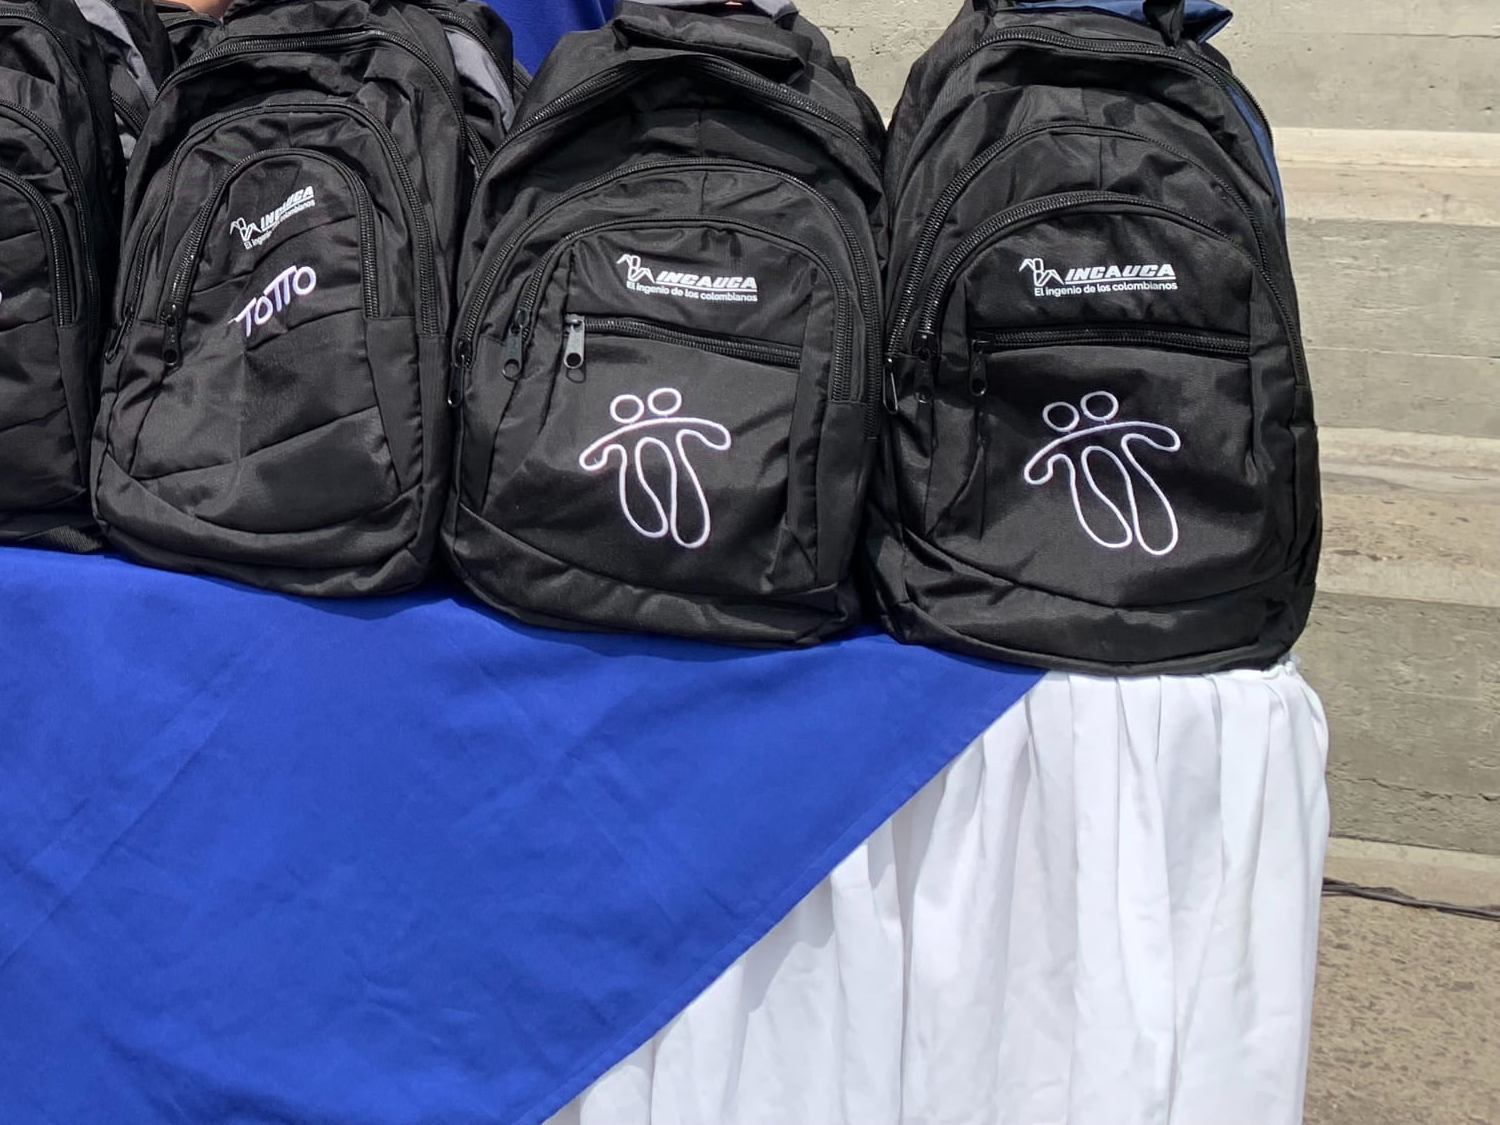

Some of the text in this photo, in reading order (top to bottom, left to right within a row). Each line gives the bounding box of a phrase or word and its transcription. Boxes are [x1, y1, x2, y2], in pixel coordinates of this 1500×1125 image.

[656, 271, 758, 290] INCAUCA
[1065, 264, 1176, 281] INCAUCA
[626, 281, 758, 302] El ingenio de los colombianos
[1034, 281, 1177, 298] El ingenio de los colombianos
[227, 265, 317, 338] TOTTO
